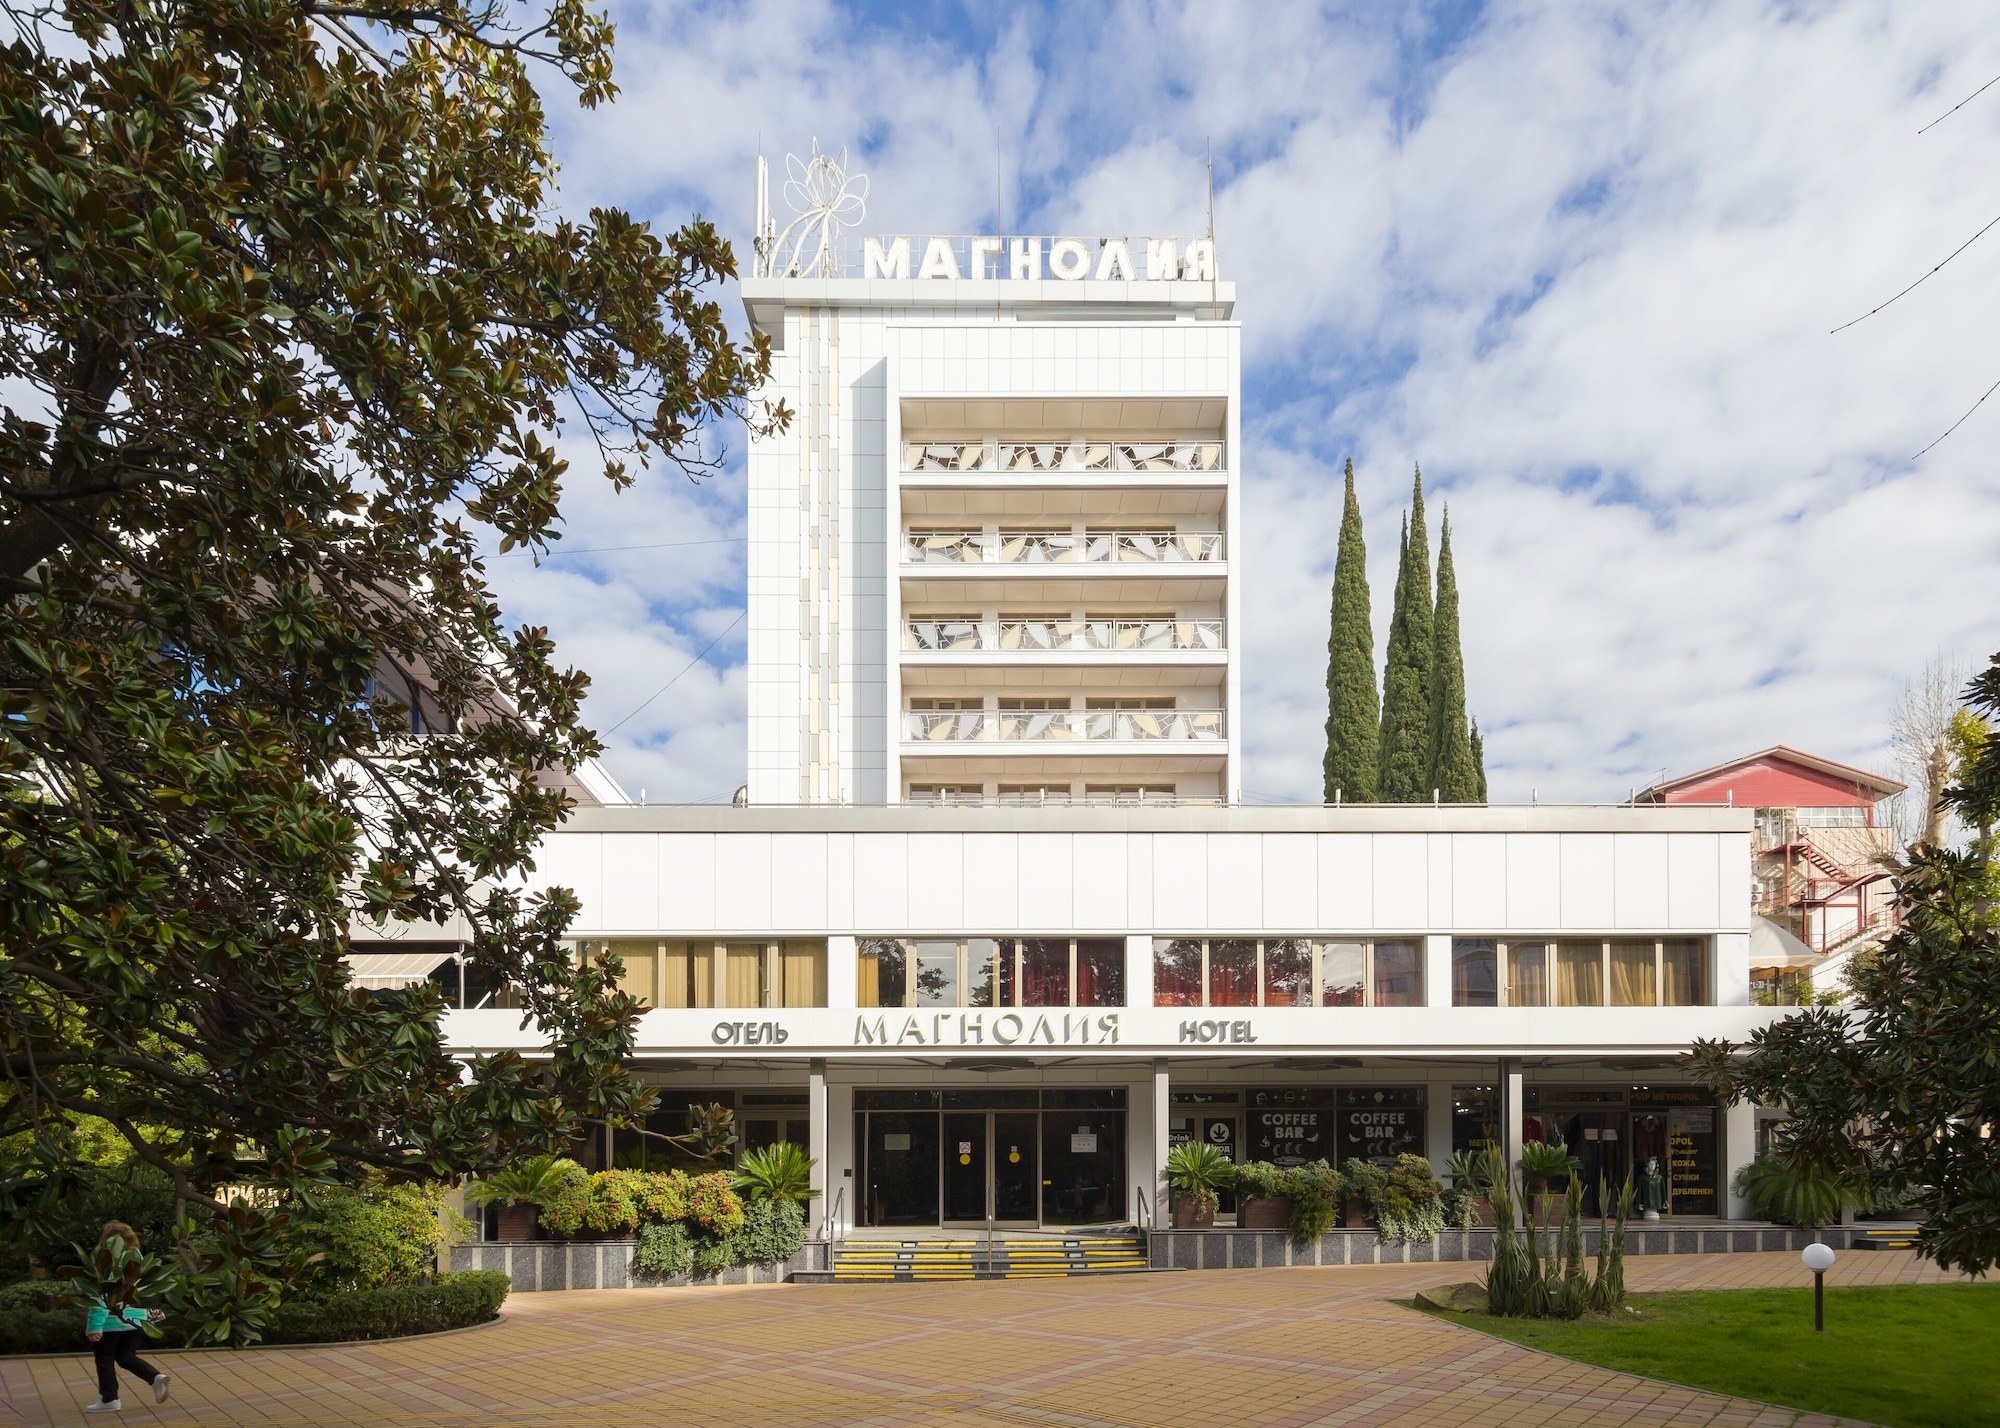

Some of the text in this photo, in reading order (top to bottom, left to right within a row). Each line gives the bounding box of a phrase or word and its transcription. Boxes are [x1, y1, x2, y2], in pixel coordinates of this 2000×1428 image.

[864, 236, 1218, 281] МАГНОЛИЯ
[711, 1021, 789, 1045] ОТЕЛЬ
[854, 1013, 1121, 1046] МАГНОЛИЯ
[1179, 1020, 1258, 1044] HOTEL
[1262, 1113, 1317, 1126] COFFEE
[1350, 1112, 1405, 1125] COFFEE
[1275, 1127, 1305, 1139] BAR
[1365, 1126, 1395, 1138] BAR
[1672, 1159, 1696, 1167] КОЖА
[1673, 1173, 1699, 1181] СУМКИ
[1672, 1187, 1713, 1196] ДУБЛЕНКИ
